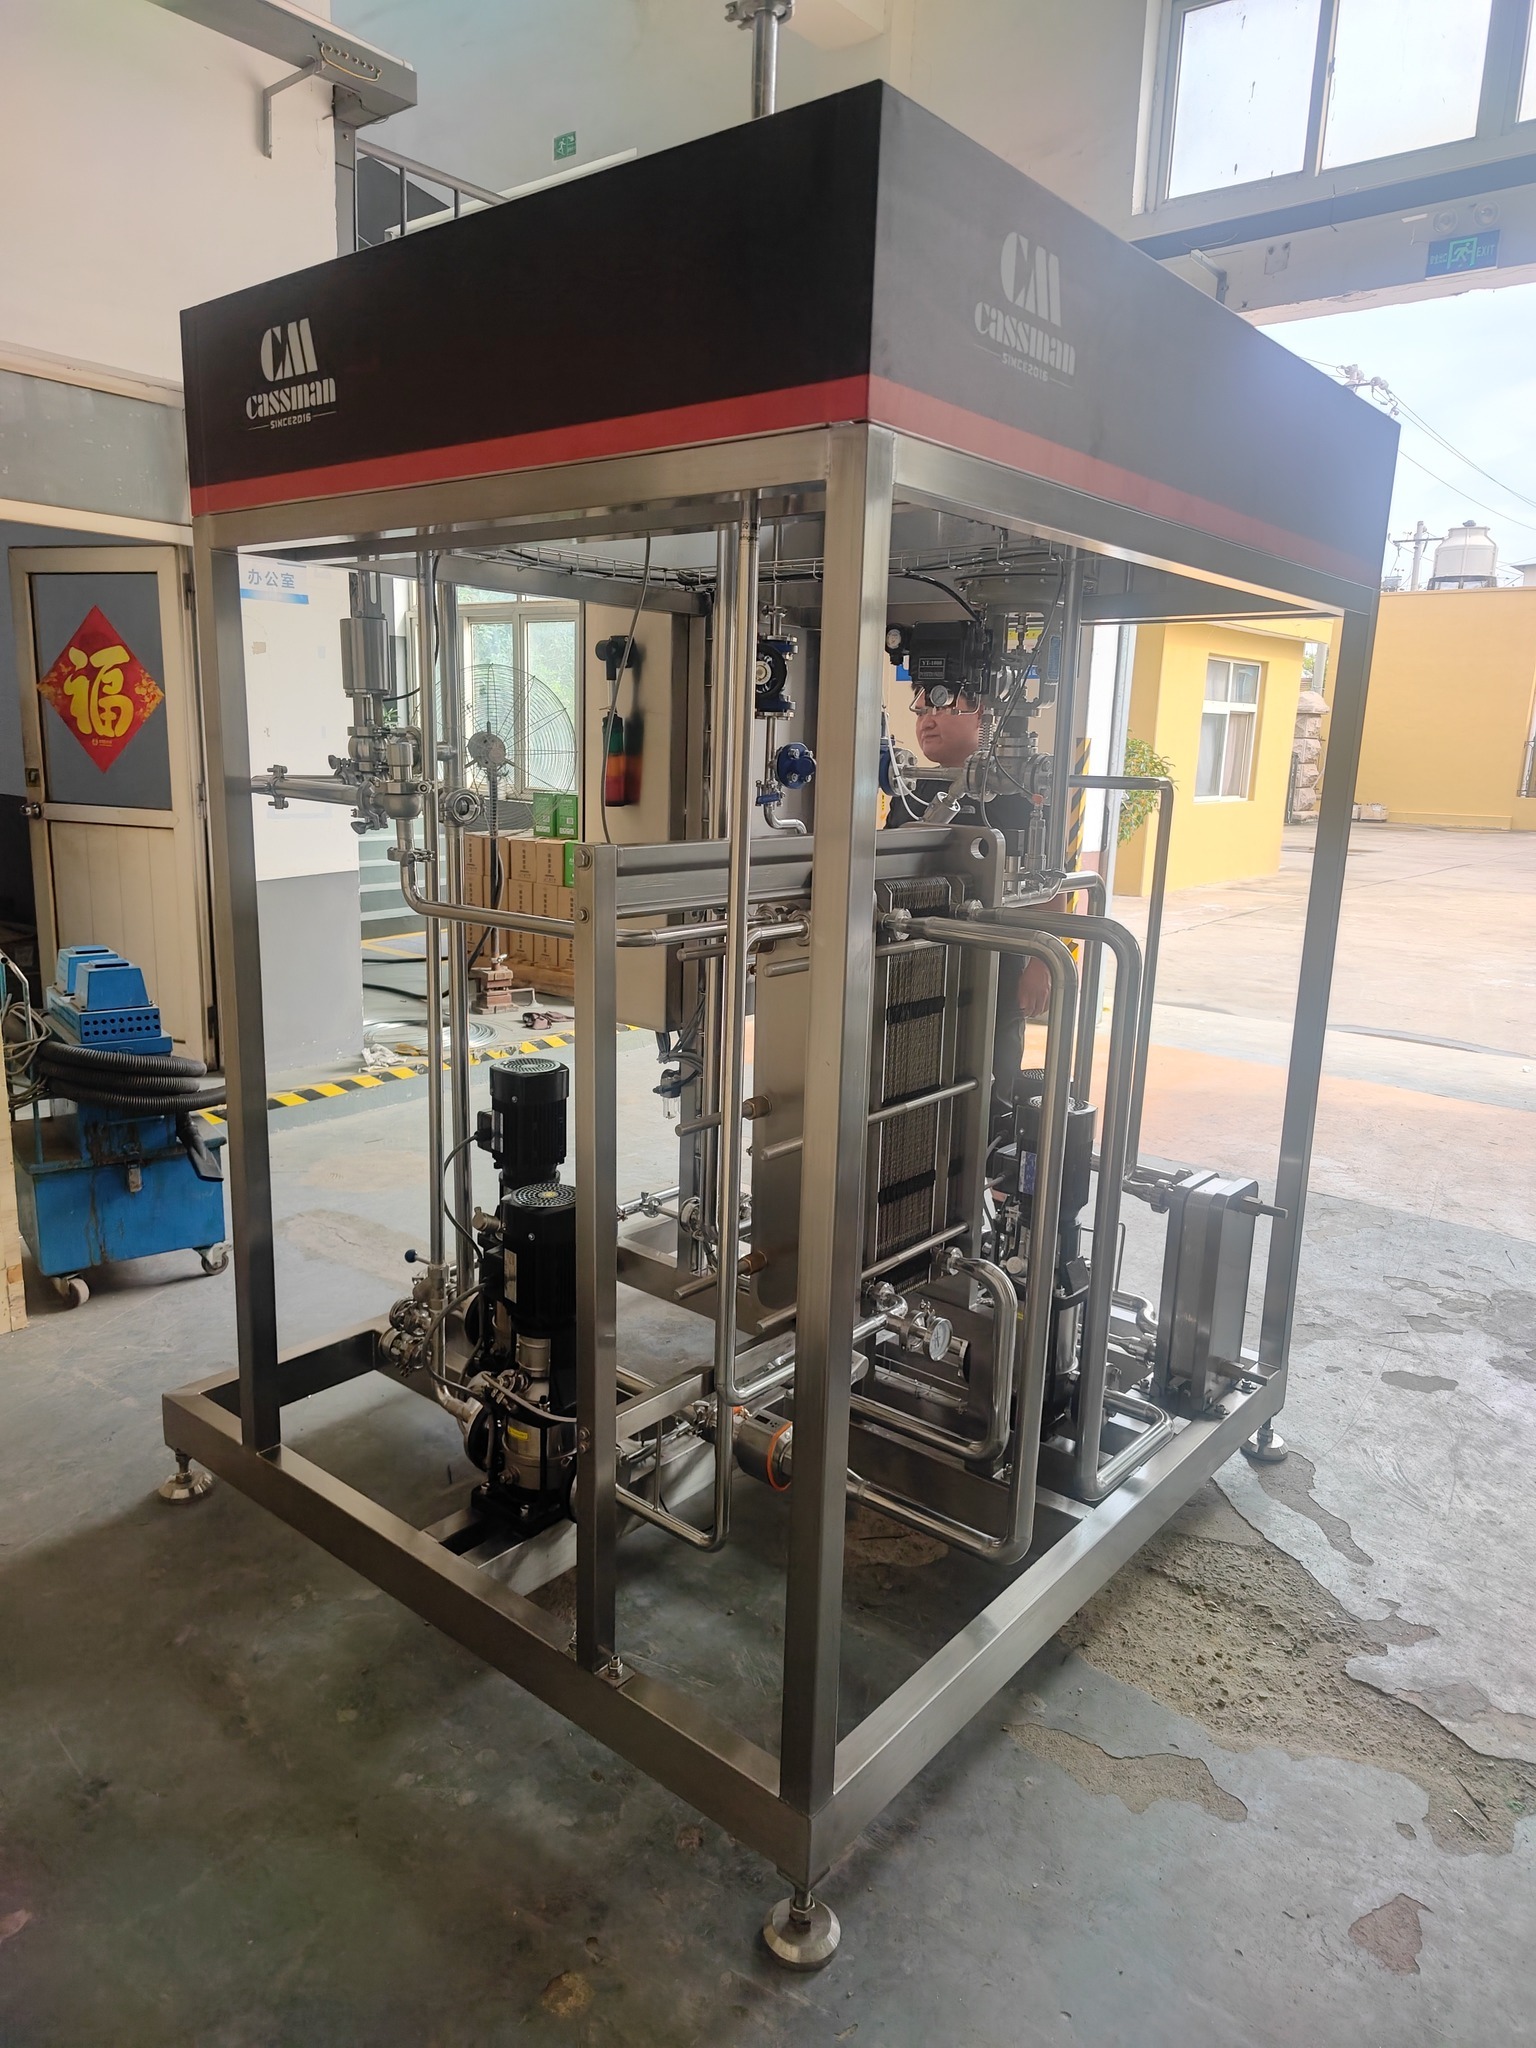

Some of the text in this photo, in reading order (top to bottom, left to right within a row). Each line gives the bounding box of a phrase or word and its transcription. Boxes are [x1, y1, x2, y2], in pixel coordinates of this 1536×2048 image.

[1477, 245, 1495, 257] EXIT
[248, 568, 295, 589] 办公室
[63, 645, 134, 738] 福
